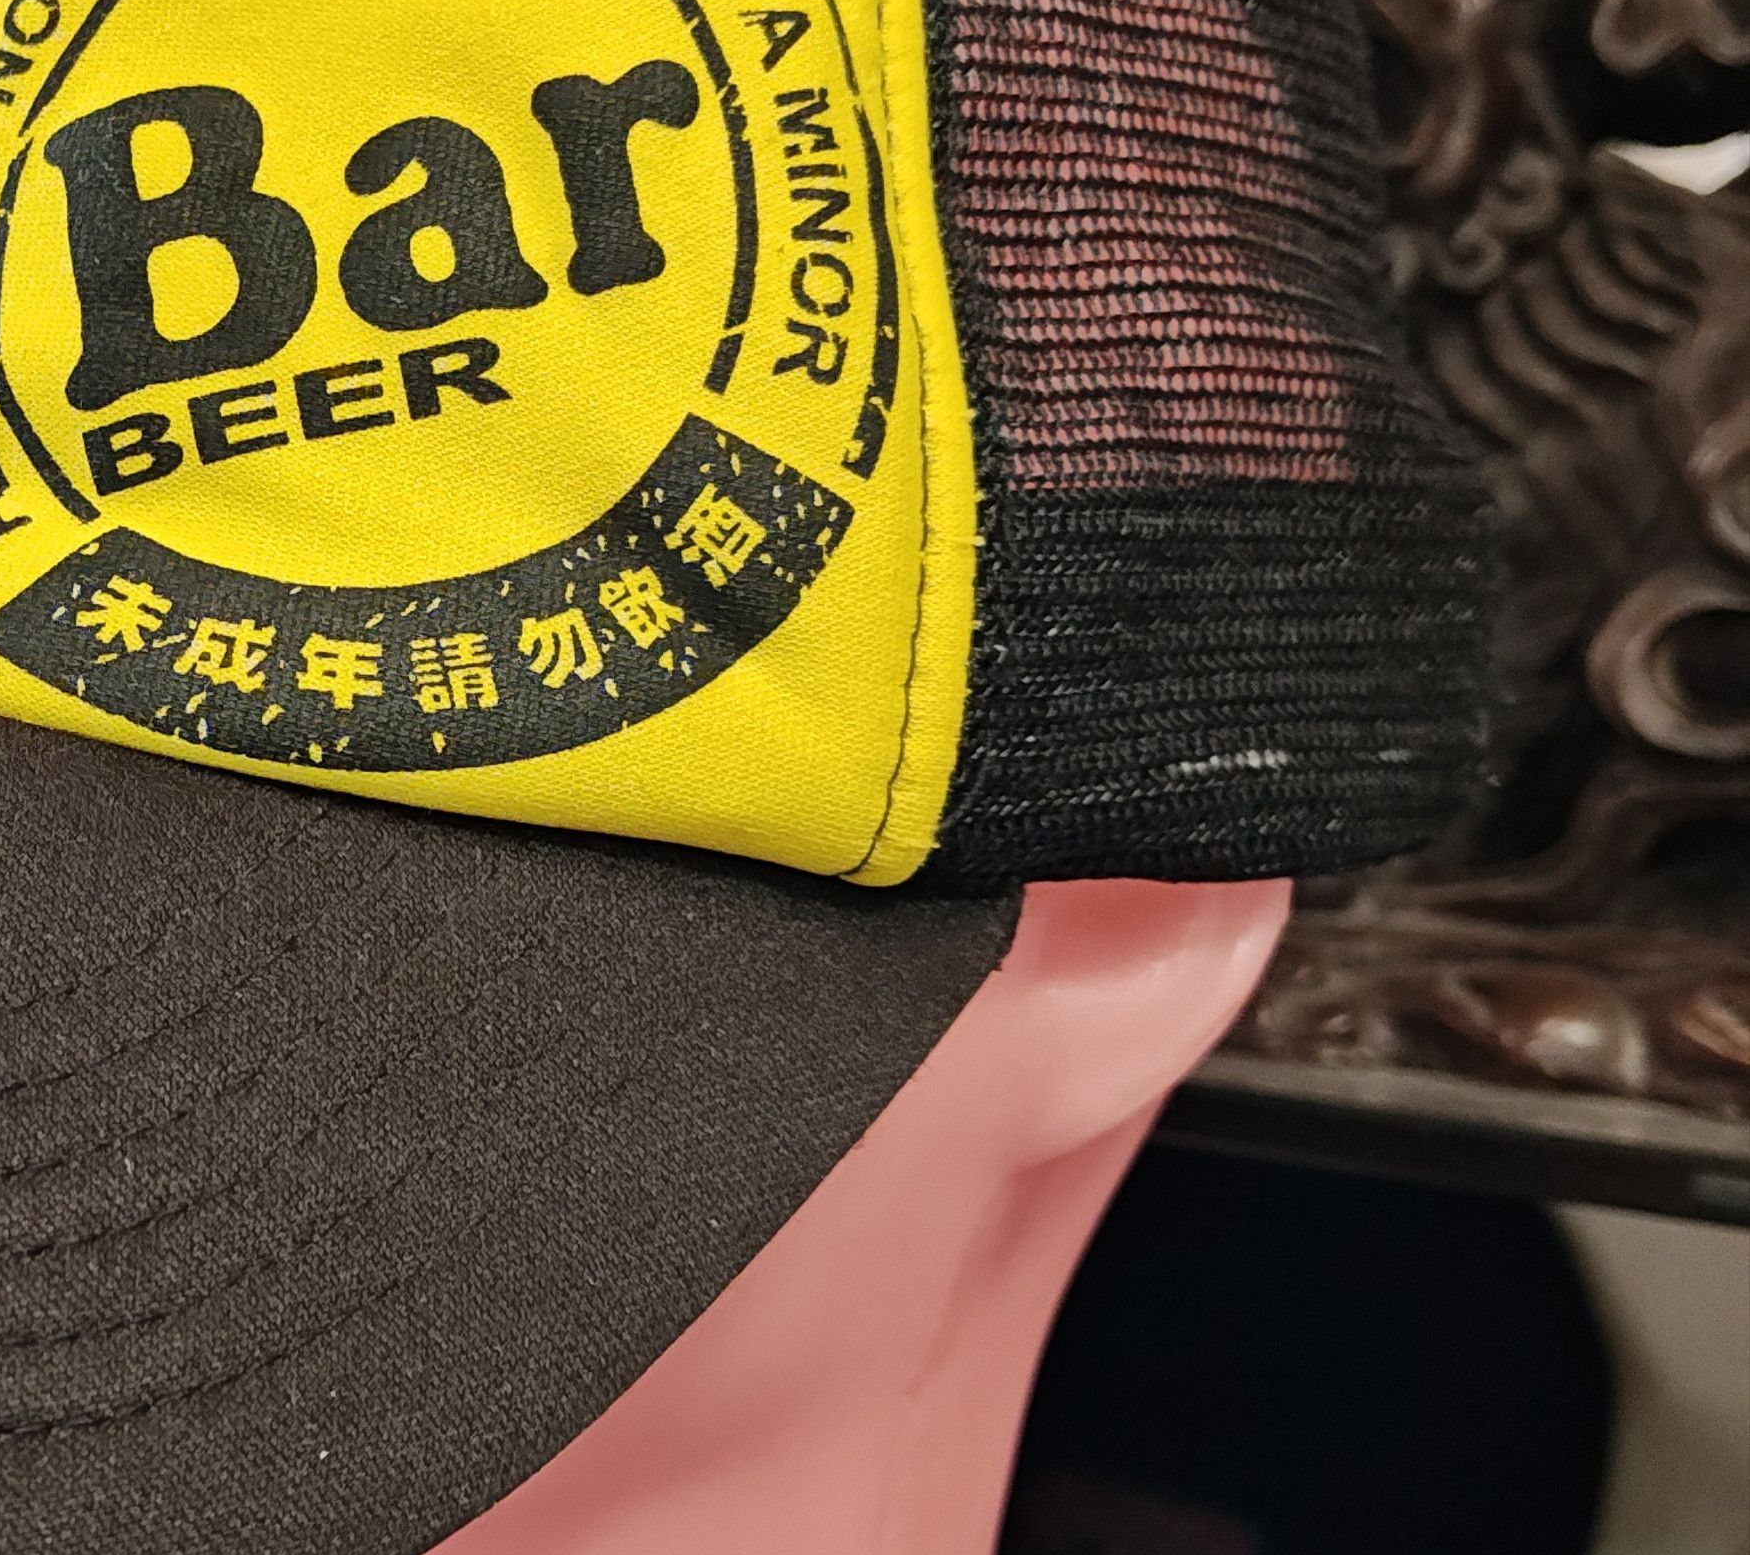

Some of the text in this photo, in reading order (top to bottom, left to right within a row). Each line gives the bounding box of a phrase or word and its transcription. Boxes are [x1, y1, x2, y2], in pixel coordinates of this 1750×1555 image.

[737, 5, 813, 73] A
[42, 58, 702, 414] Bar
[771, 85, 856, 387] MINOR
[80, 336, 514, 498] BEER
[74, 482, 770, 714] 未成年請勿飲酒
